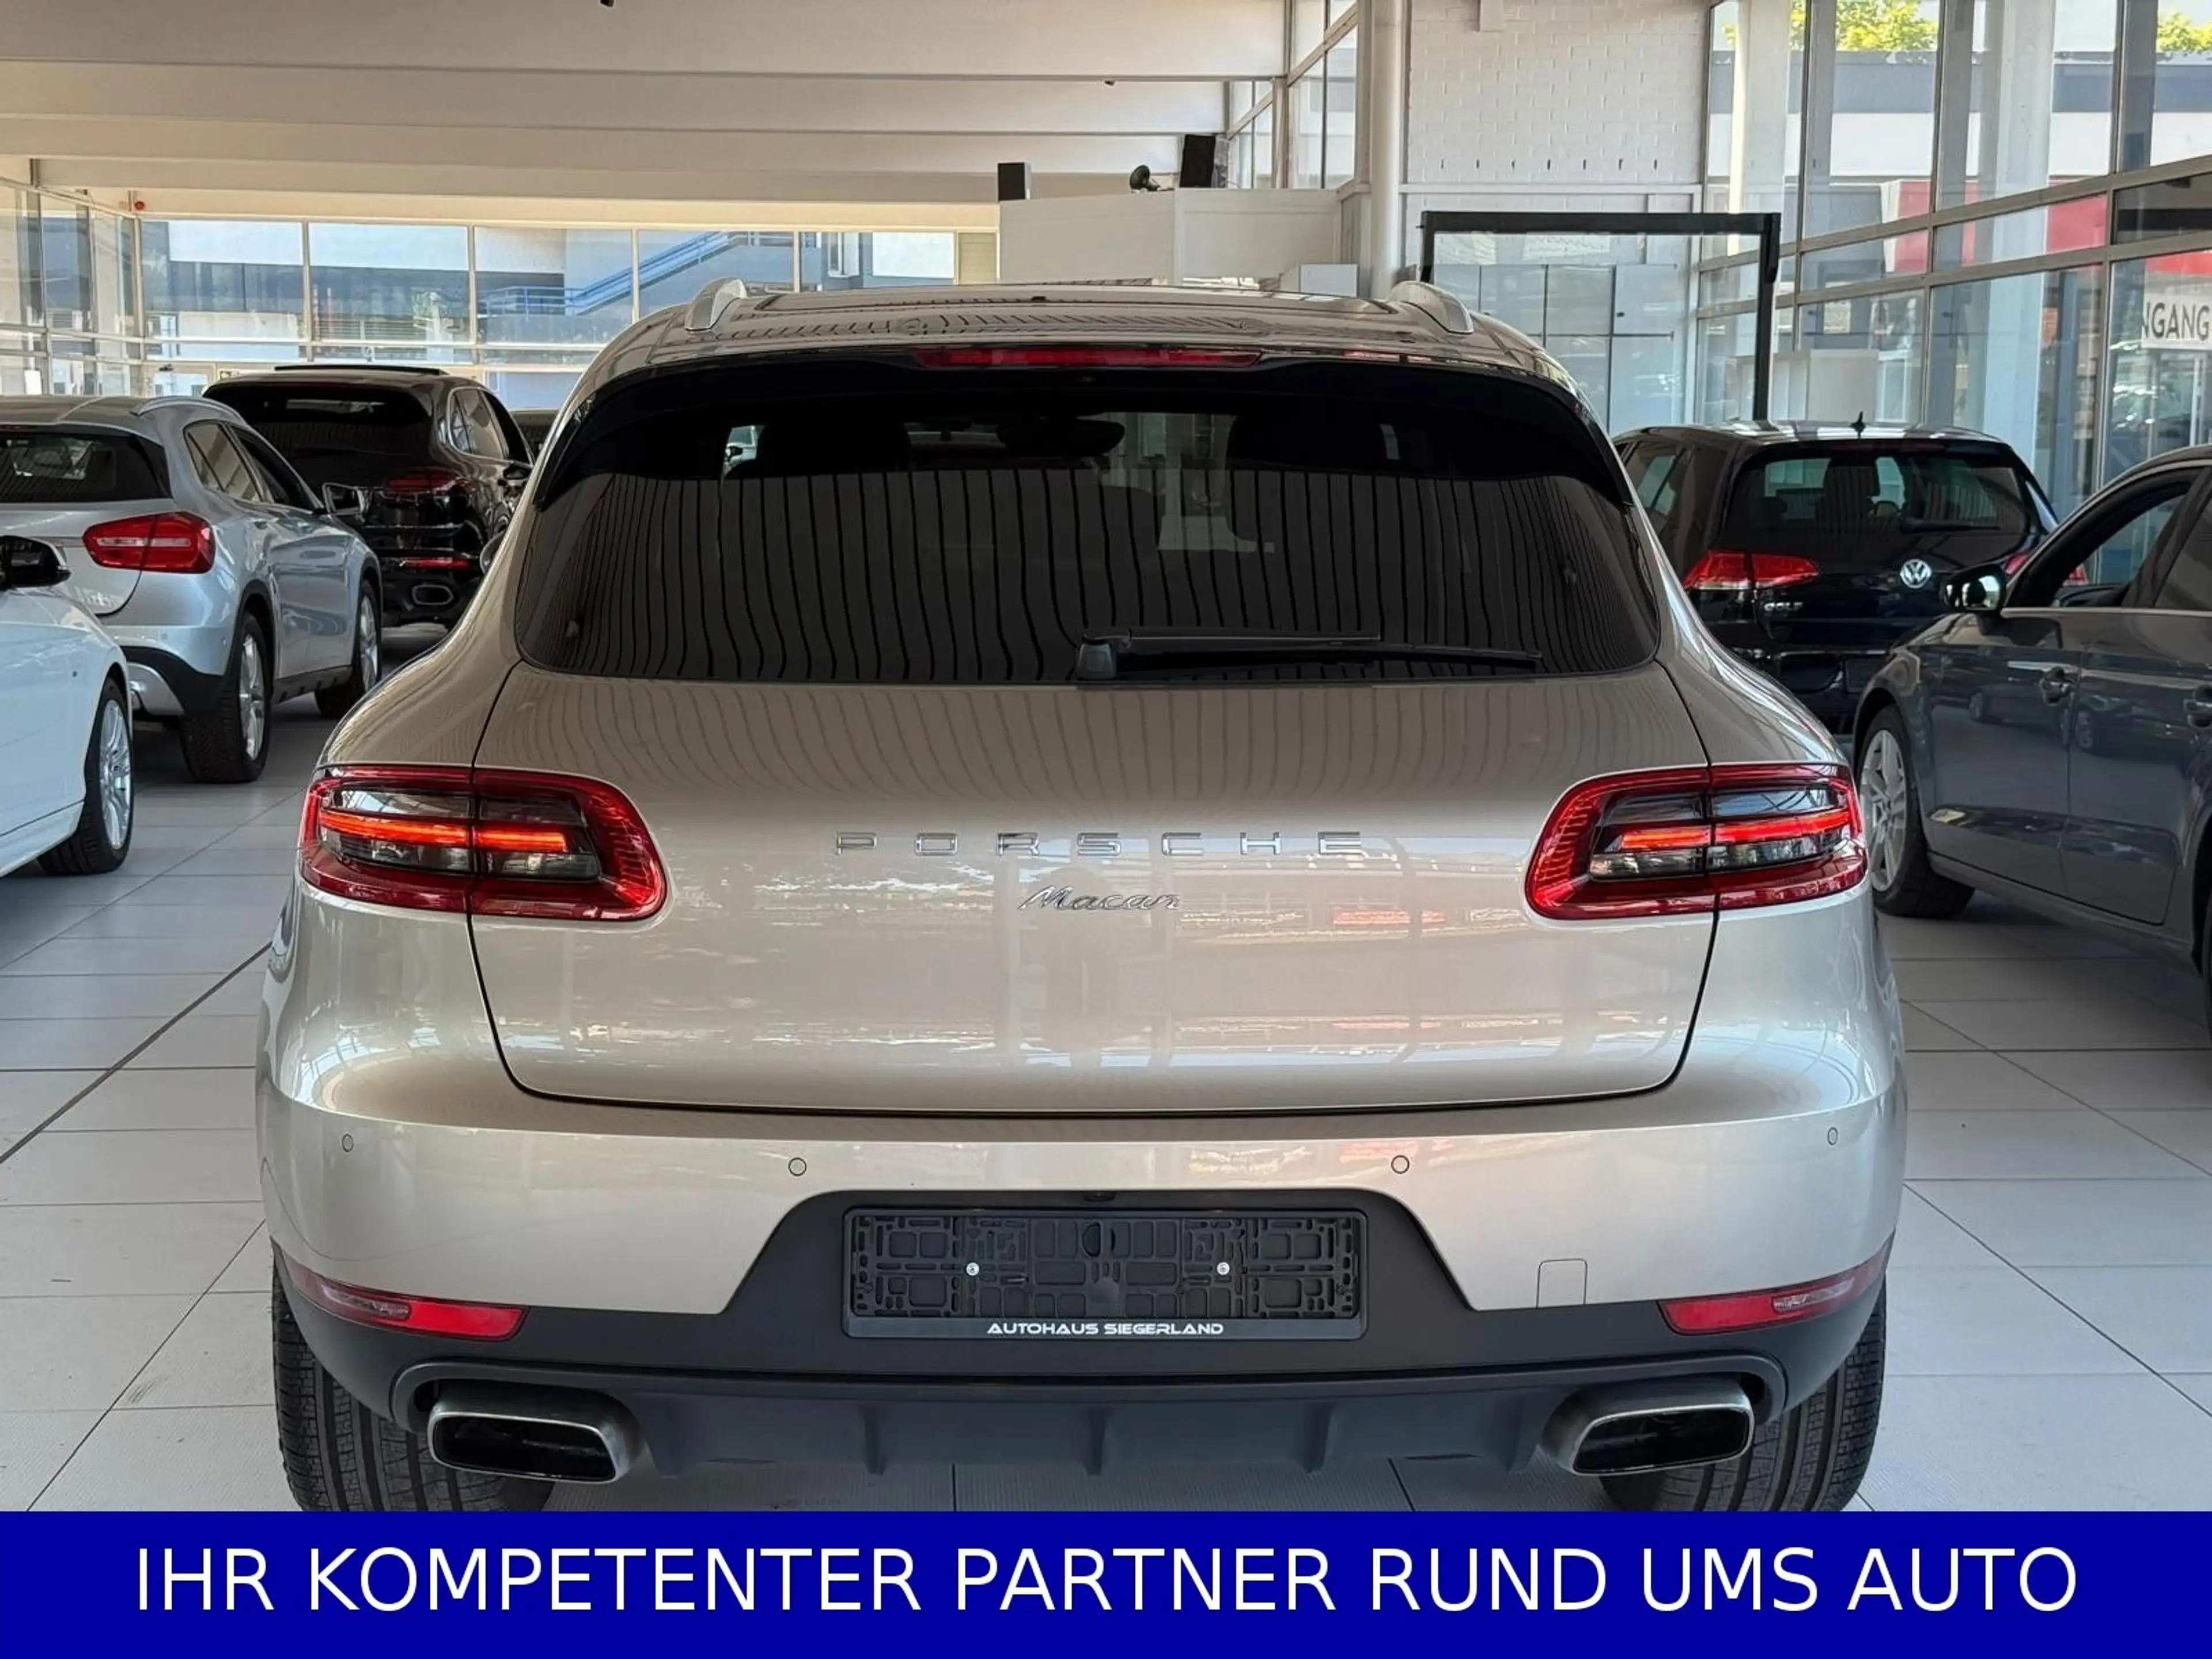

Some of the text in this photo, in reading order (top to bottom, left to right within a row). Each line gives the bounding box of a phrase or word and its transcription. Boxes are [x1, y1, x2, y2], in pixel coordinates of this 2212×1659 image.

[836, 831, 1362, 857] PORSCHE
[1017, 885, 1180, 911] Macan
[987, 1323, 1224, 1336] AUTOHAUS SIEGERLAND
